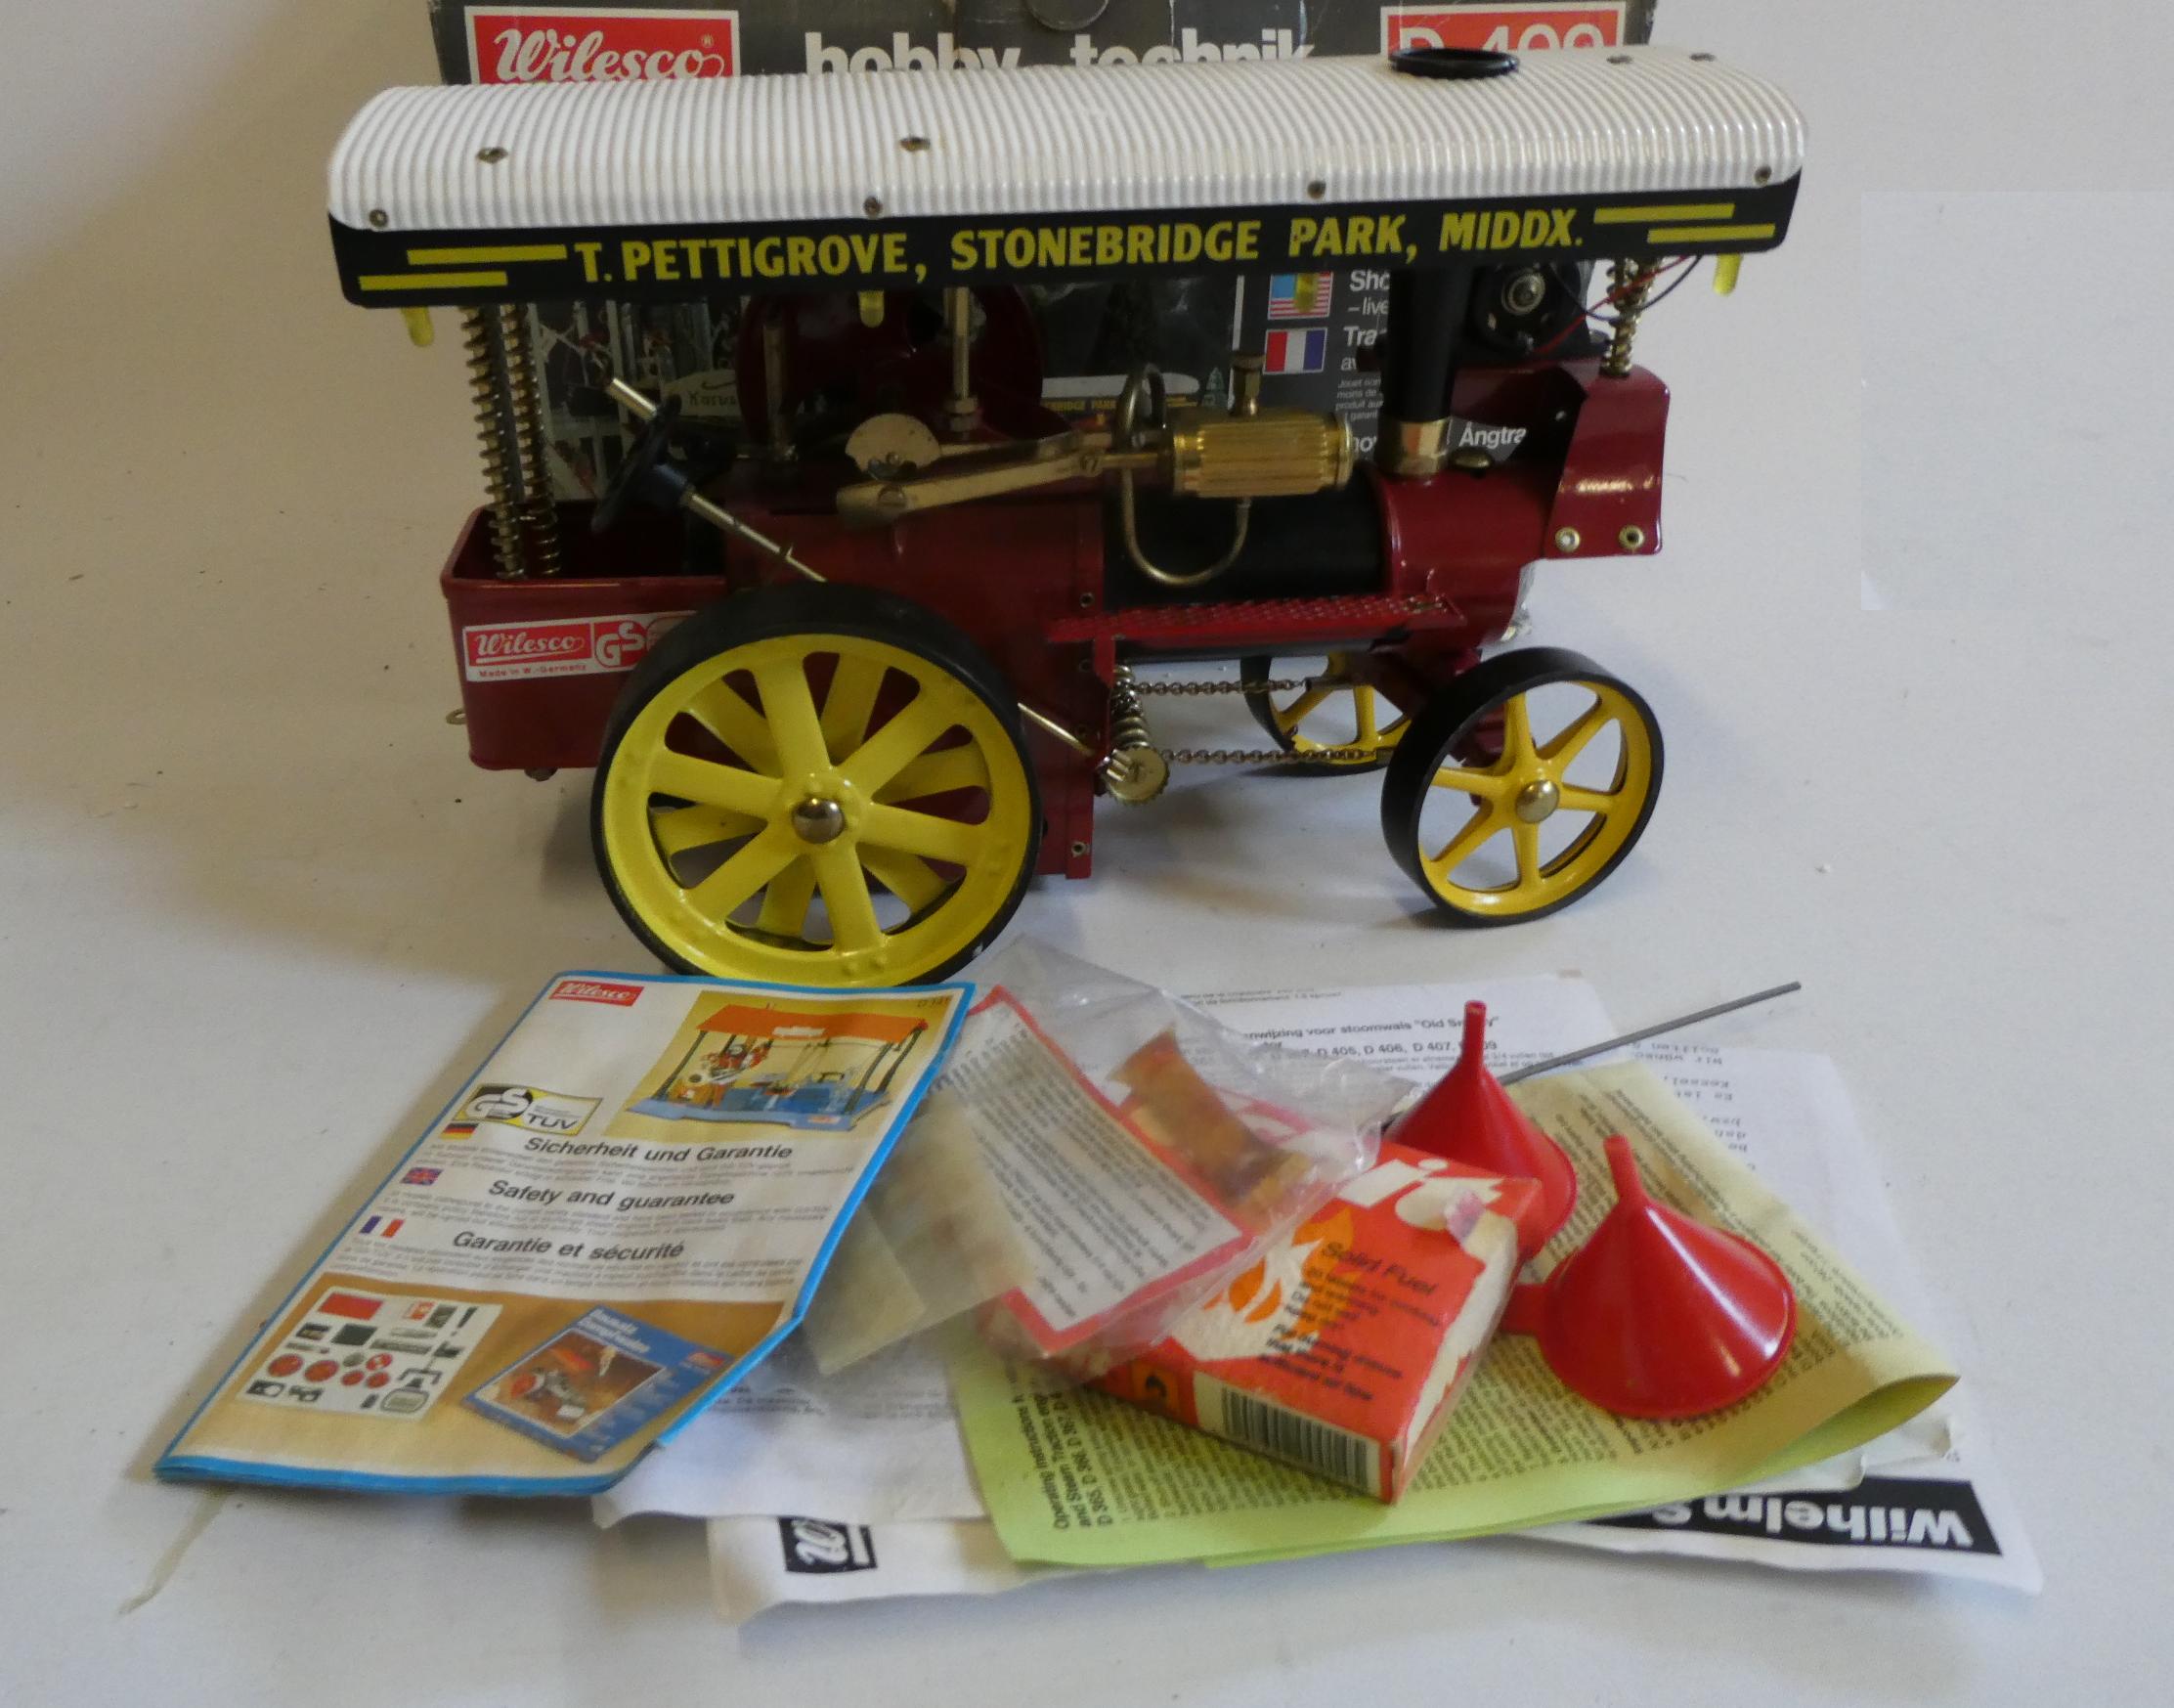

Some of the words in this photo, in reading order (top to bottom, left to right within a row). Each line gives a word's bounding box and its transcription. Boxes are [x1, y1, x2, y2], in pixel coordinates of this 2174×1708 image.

[494, 27, 723, 81] Wilesco
[950, 221, 1260, 271] STONEBRIDGE
[1288, 214, 1419, 265] PARK,
[1438, 209, 1584, 252] MIDDX.
[1343, 326, 1387, 346] Tra
[476, 632, 585, 655] Wilesco
[524, 1137, 638, 1159] Sicherheit
[643, 1147, 691, 1161] und
[696, 1143, 793, 1161] Garantie
[489, 1179, 562, 1205] Safety
[566, 1190, 615, 1206] and
[616, 1192, 735, 1212] guarantee
[453, 1230, 551, 1255] Garantie
[559, 1243, 586, 1258] et
[590, 1240, 683, 1260] sécurité
[1704, 1492, 1974, 1548] Wilhelm
